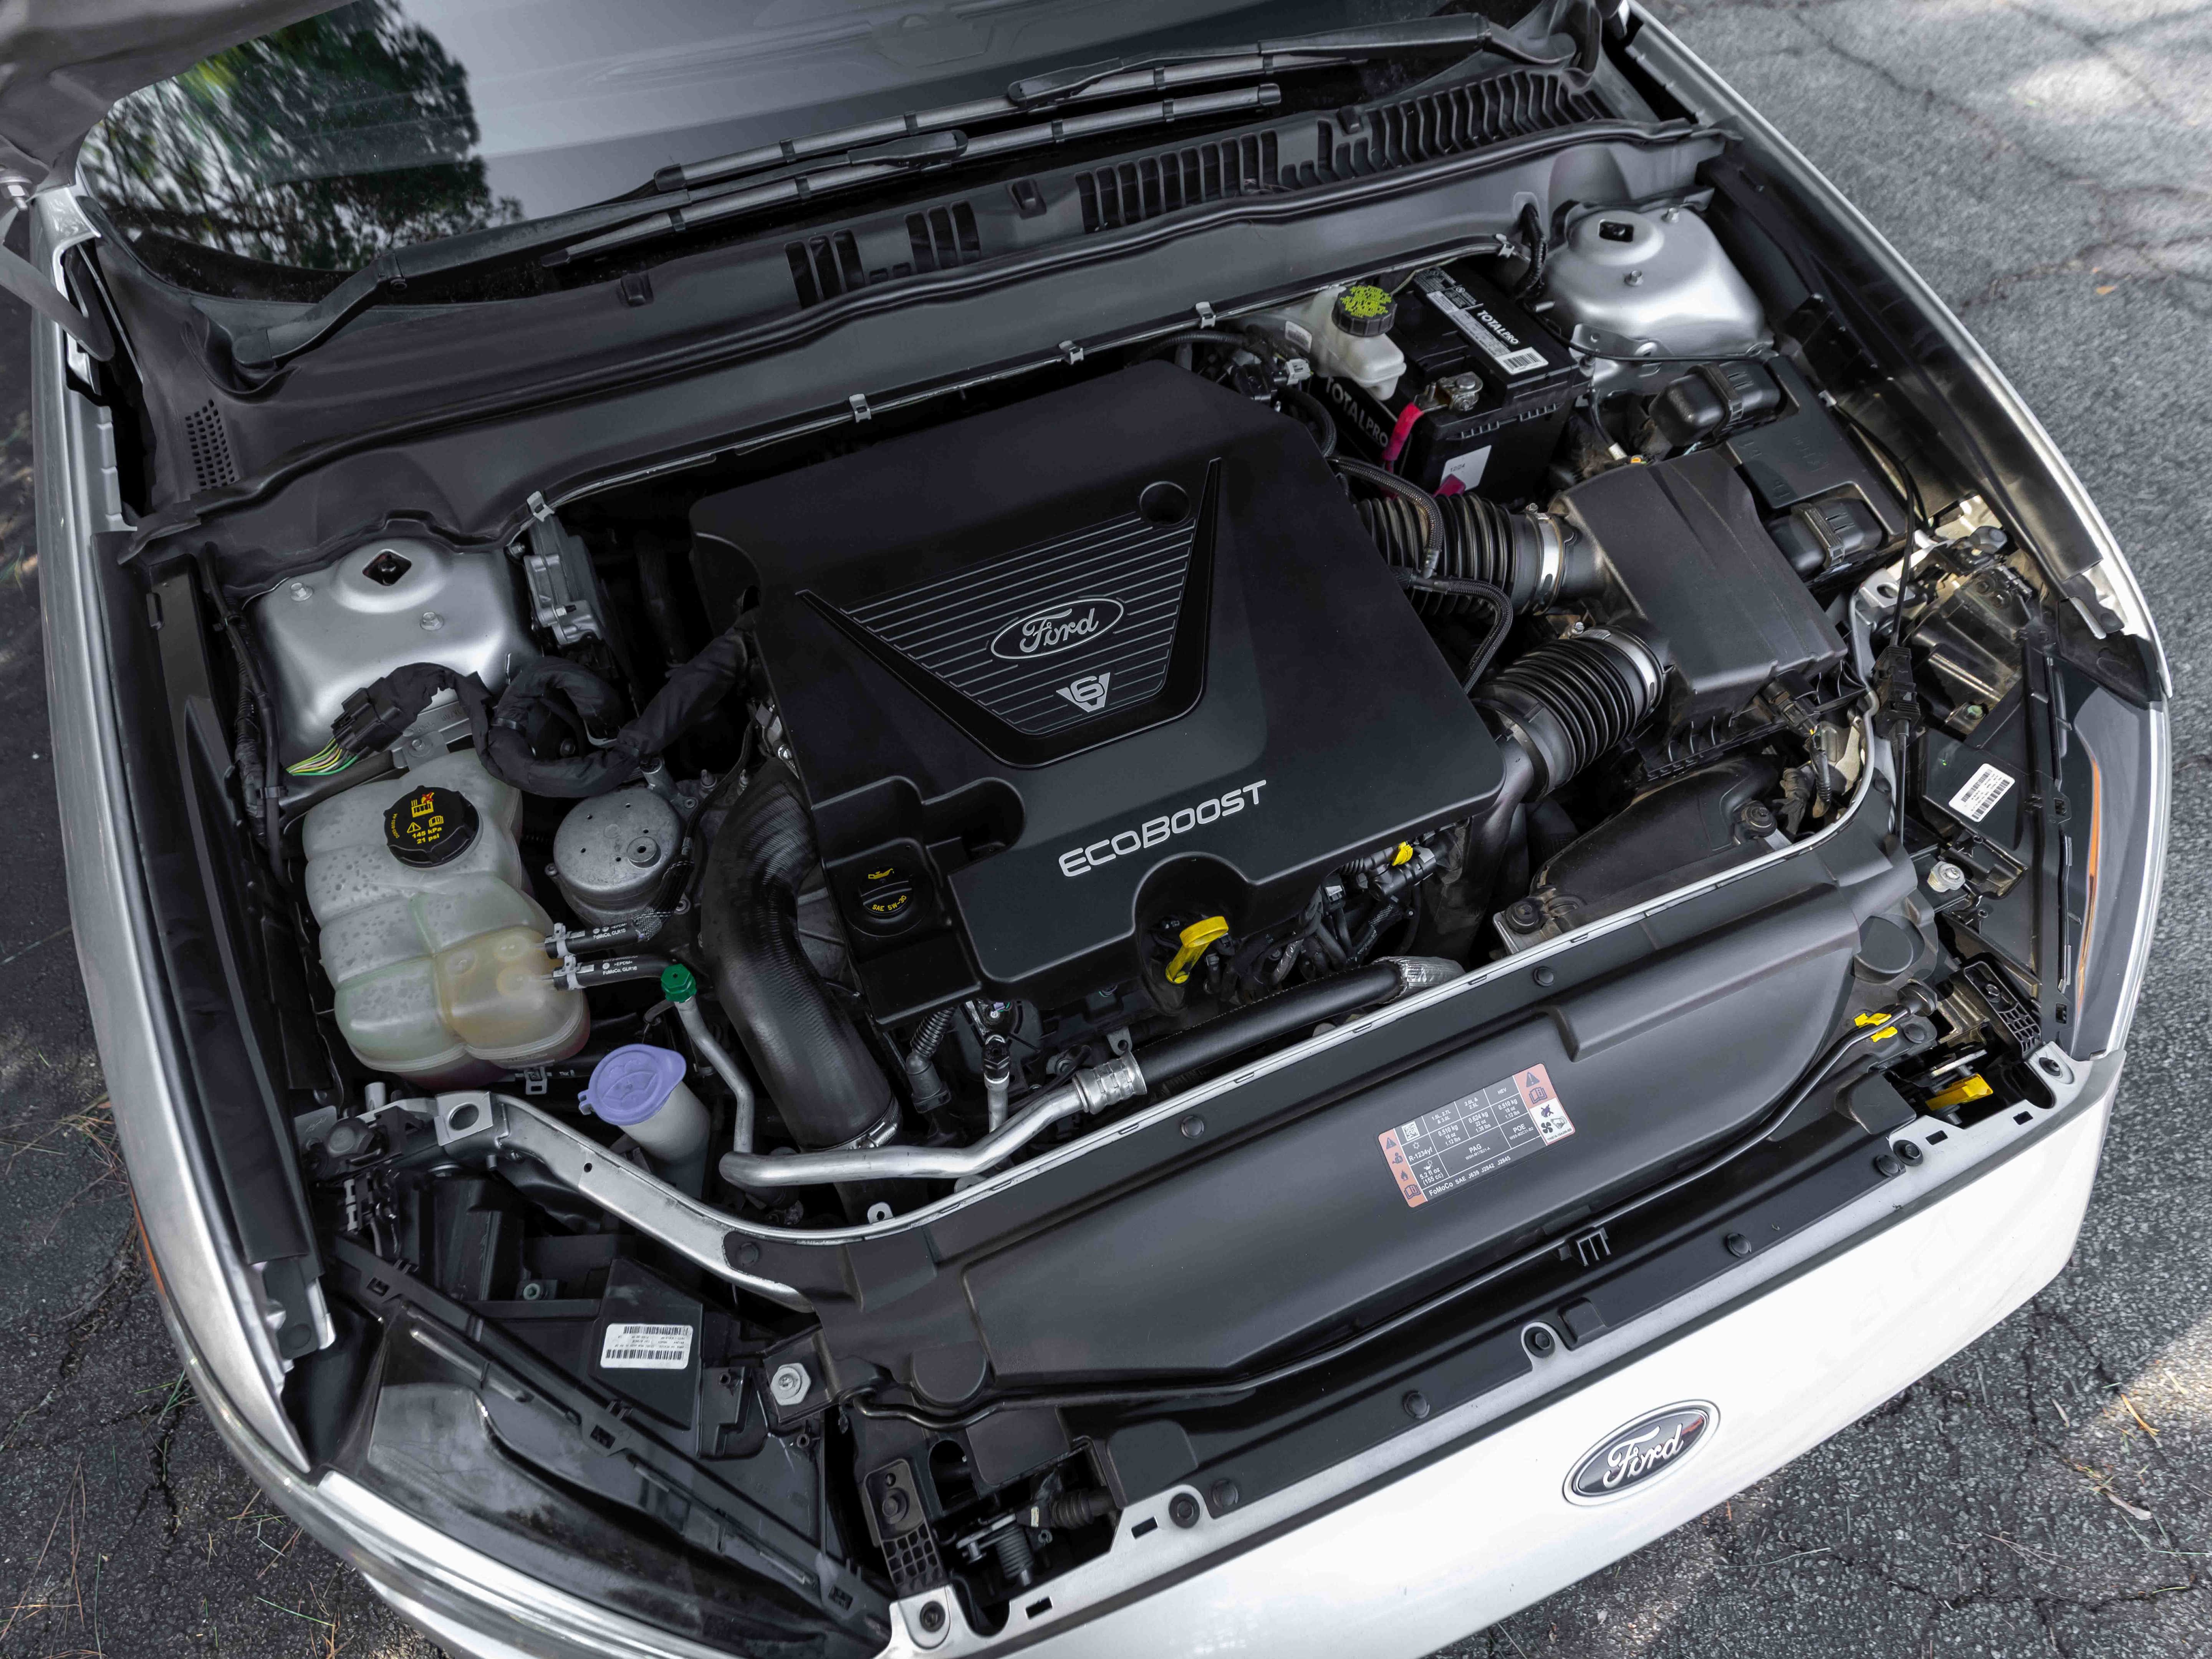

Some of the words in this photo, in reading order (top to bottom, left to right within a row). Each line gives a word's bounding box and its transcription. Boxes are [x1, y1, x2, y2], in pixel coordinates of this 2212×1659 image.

[1476, 310, 1520, 345] TOTALPRO
[1325, 377, 1389, 447] TOTALPRO
[1020, 608, 1099, 653] Ford
[412, 831, 426, 839] 145
[1058, 780, 1266, 878] ECOBOOST
[428, 833, 440, 842] psi
[887, 895, 907, 911] 5W-30
[593, 931, 611, 940] FoMoCo,
[1498, 1101, 1511, 1110] 0.510
[1511, 1098, 1518, 1106] kg
[1468, 1114, 1482, 1123] 0.624
[1481, 1111, 1488, 1119] kg
[1437, 1127, 1451, 1137] 0.510
[1451, 1124, 1459, 1132] kg
[1513, 1123, 1526, 1133] POE
[1409, 1147, 1433, 1162] R-1234yf
[1469, 1144, 1482, 1153] PAG
[1422, 1176, 1434, 1186] (155
[1434, 1172, 1444, 1182] cc)
[1429, 1182, 1453, 1196] FoMoCo
[1455, 1176, 1466, 1185] SAE
[1468, 1170, 1480, 1179] J639
[1481, 1163, 1495, 1173] J2842
[1497, 1156, 1511, 1166] J2845
[1603, 1423, 1684, 1488] Ford
